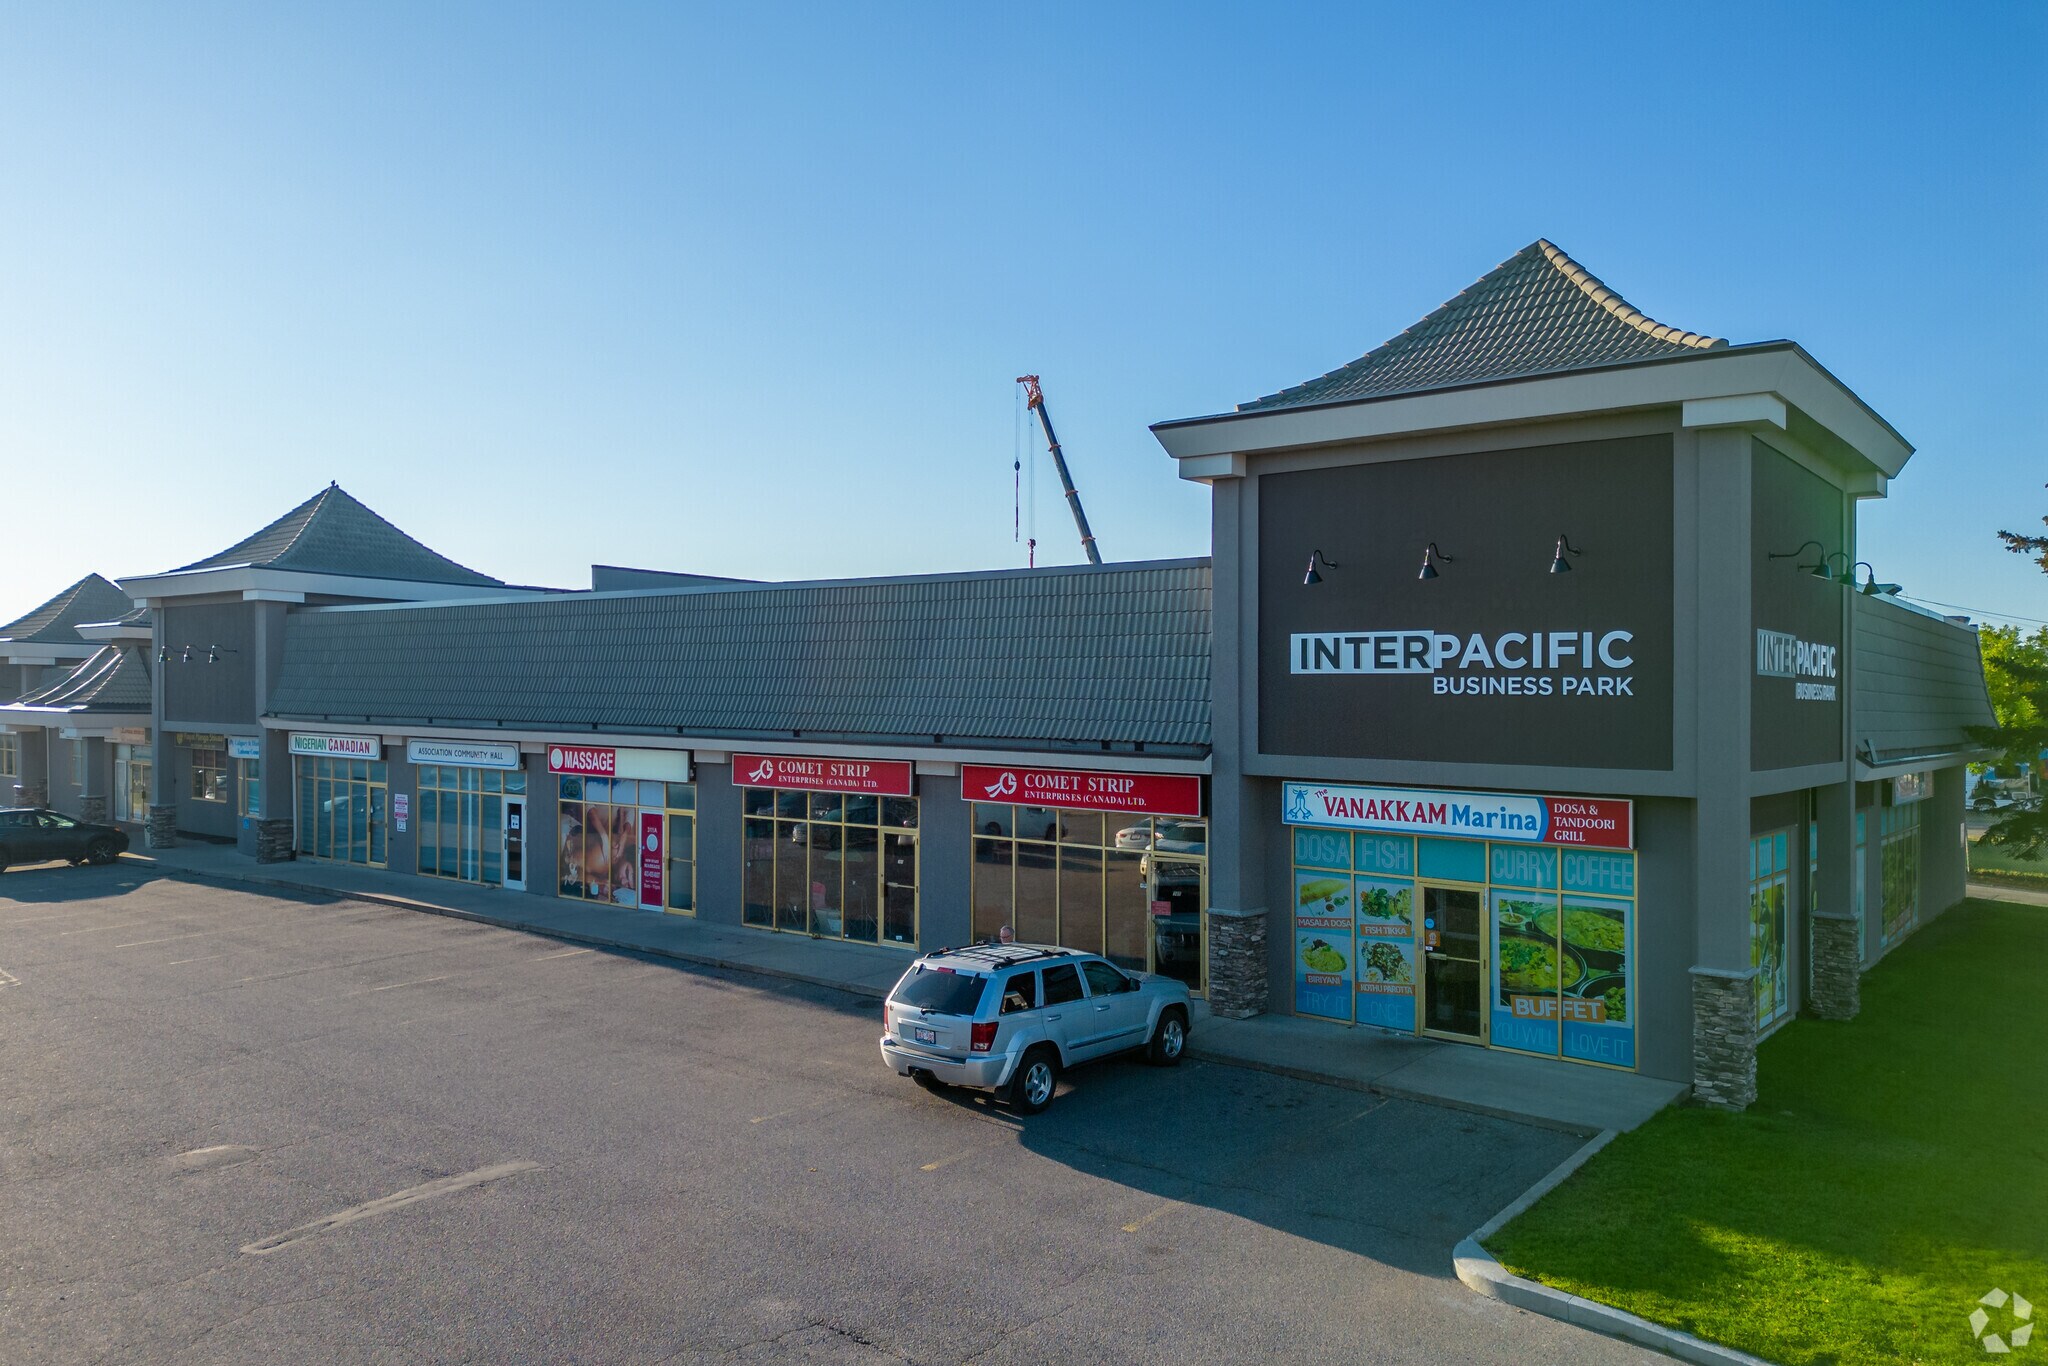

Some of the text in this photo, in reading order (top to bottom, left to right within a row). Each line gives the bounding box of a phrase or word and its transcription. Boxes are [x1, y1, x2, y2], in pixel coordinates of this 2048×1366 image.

[1433, 676, 1635, 697] BUSINESS PARK
[294, 736, 370, 754] NIGERIAN CANADIAN
[418, 747, 504, 760] ASSOCIATION COMMUNITY HALL
[564, 750, 614, 772] MASSAGE
[778, 760, 871, 777] COMET STRIP
[778, 775, 879, 788] ENTERPRISES (CANADA) LTD.
[1024, 773, 1135, 794] COMET STRIP
[1024, 790, 1147, 806] ENTERPRISES (CANADA) LTD.
[1314, 788, 1329, 799] The
[1323, 796, 1539, 832] VANAKKAM Marina
[1553, 802, 1599, 816] DOSA &
[1553, 815, 1616, 830] TANDOORI
[1553, 829, 1587, 843] GRILL
[1295, 832, 1350, 865] DOSA
[1361, 838, 1409, 871] FISH
[1492, 848, 1557, 883] CURRY
[1564, 854, 1634, 891] COFFEE
[1297, 918, 1352, 928] MASALA DOSA
[1365, 926, 1408, 936] FISH TIKKA
[1308, 975, 1341, 985] BIRIYANI
[1303, 990, 1348, 1014] TRY IT
[1515, 998, 1601, 1020] BUFFET
[1492, 1020, 1552, 1046] YOU WILL
[1570, 1033, 1629, 1060] LOVE IT
